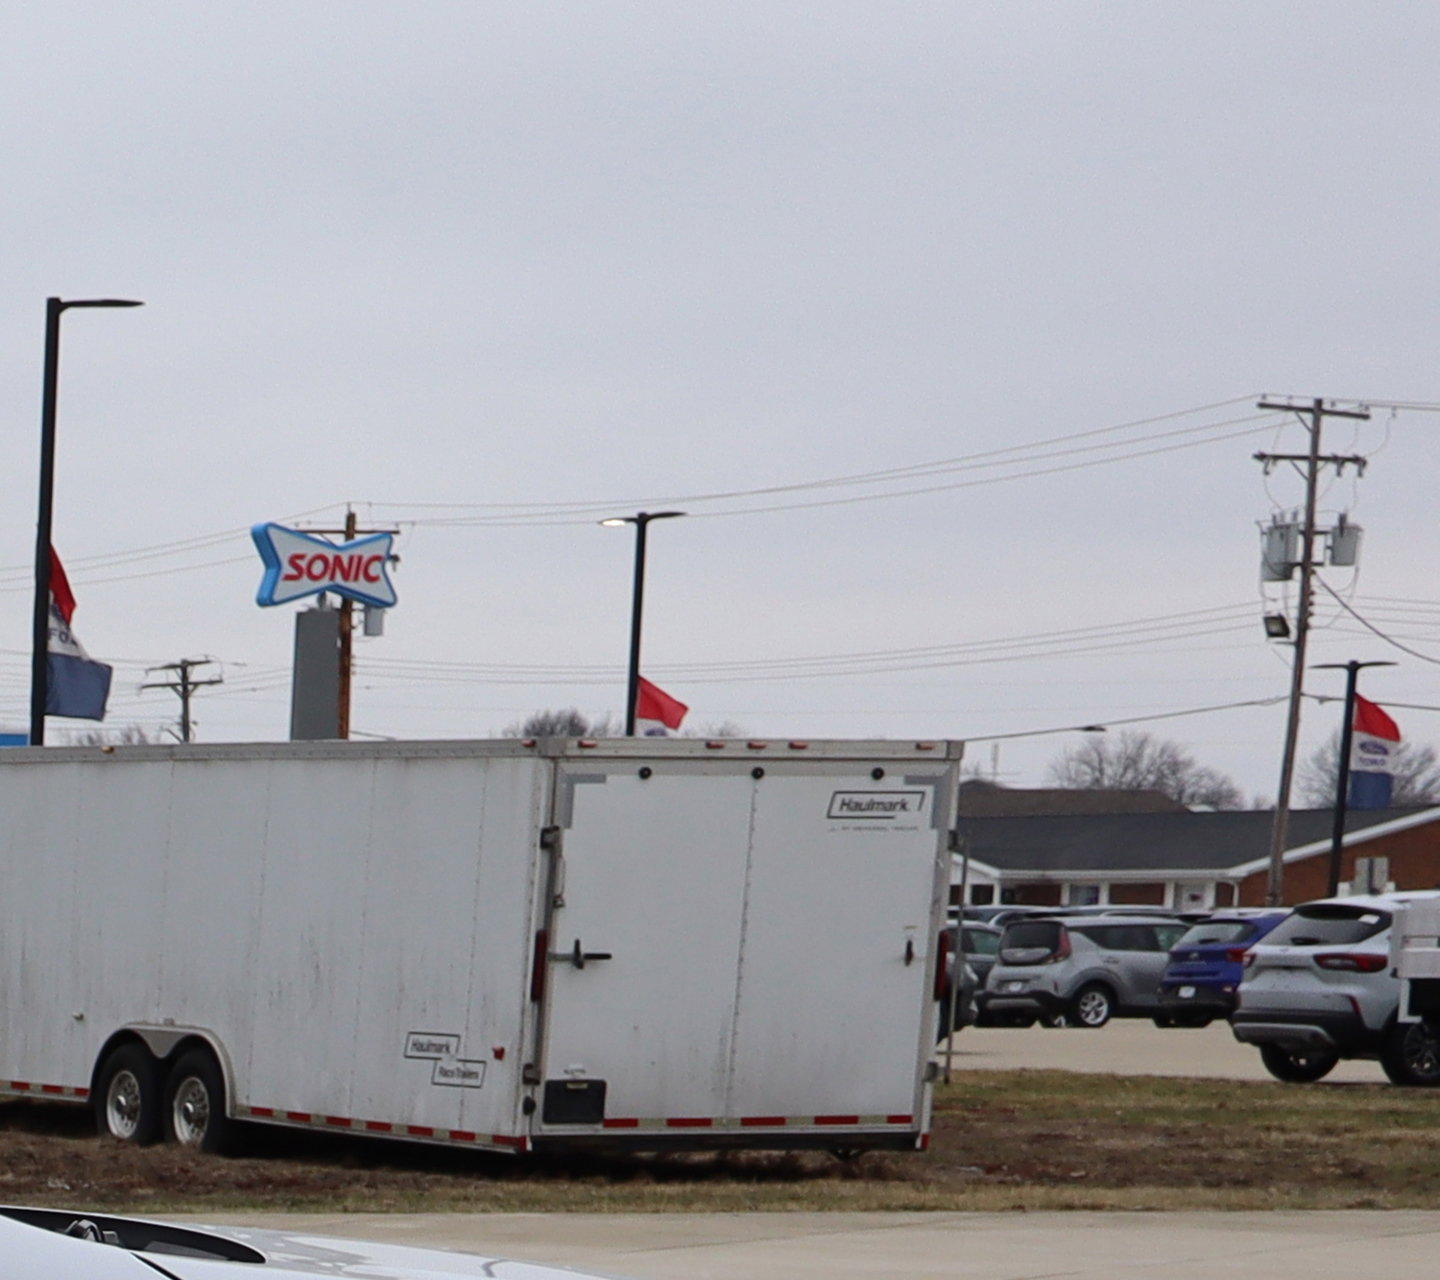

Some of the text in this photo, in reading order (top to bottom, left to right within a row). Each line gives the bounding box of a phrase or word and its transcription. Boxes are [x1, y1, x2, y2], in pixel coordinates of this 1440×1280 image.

[282, 553, 385, 583] SONIC
[838, 797, 910, 813] Haulmark
[410, 1037, 451, 1054] Haulmark
